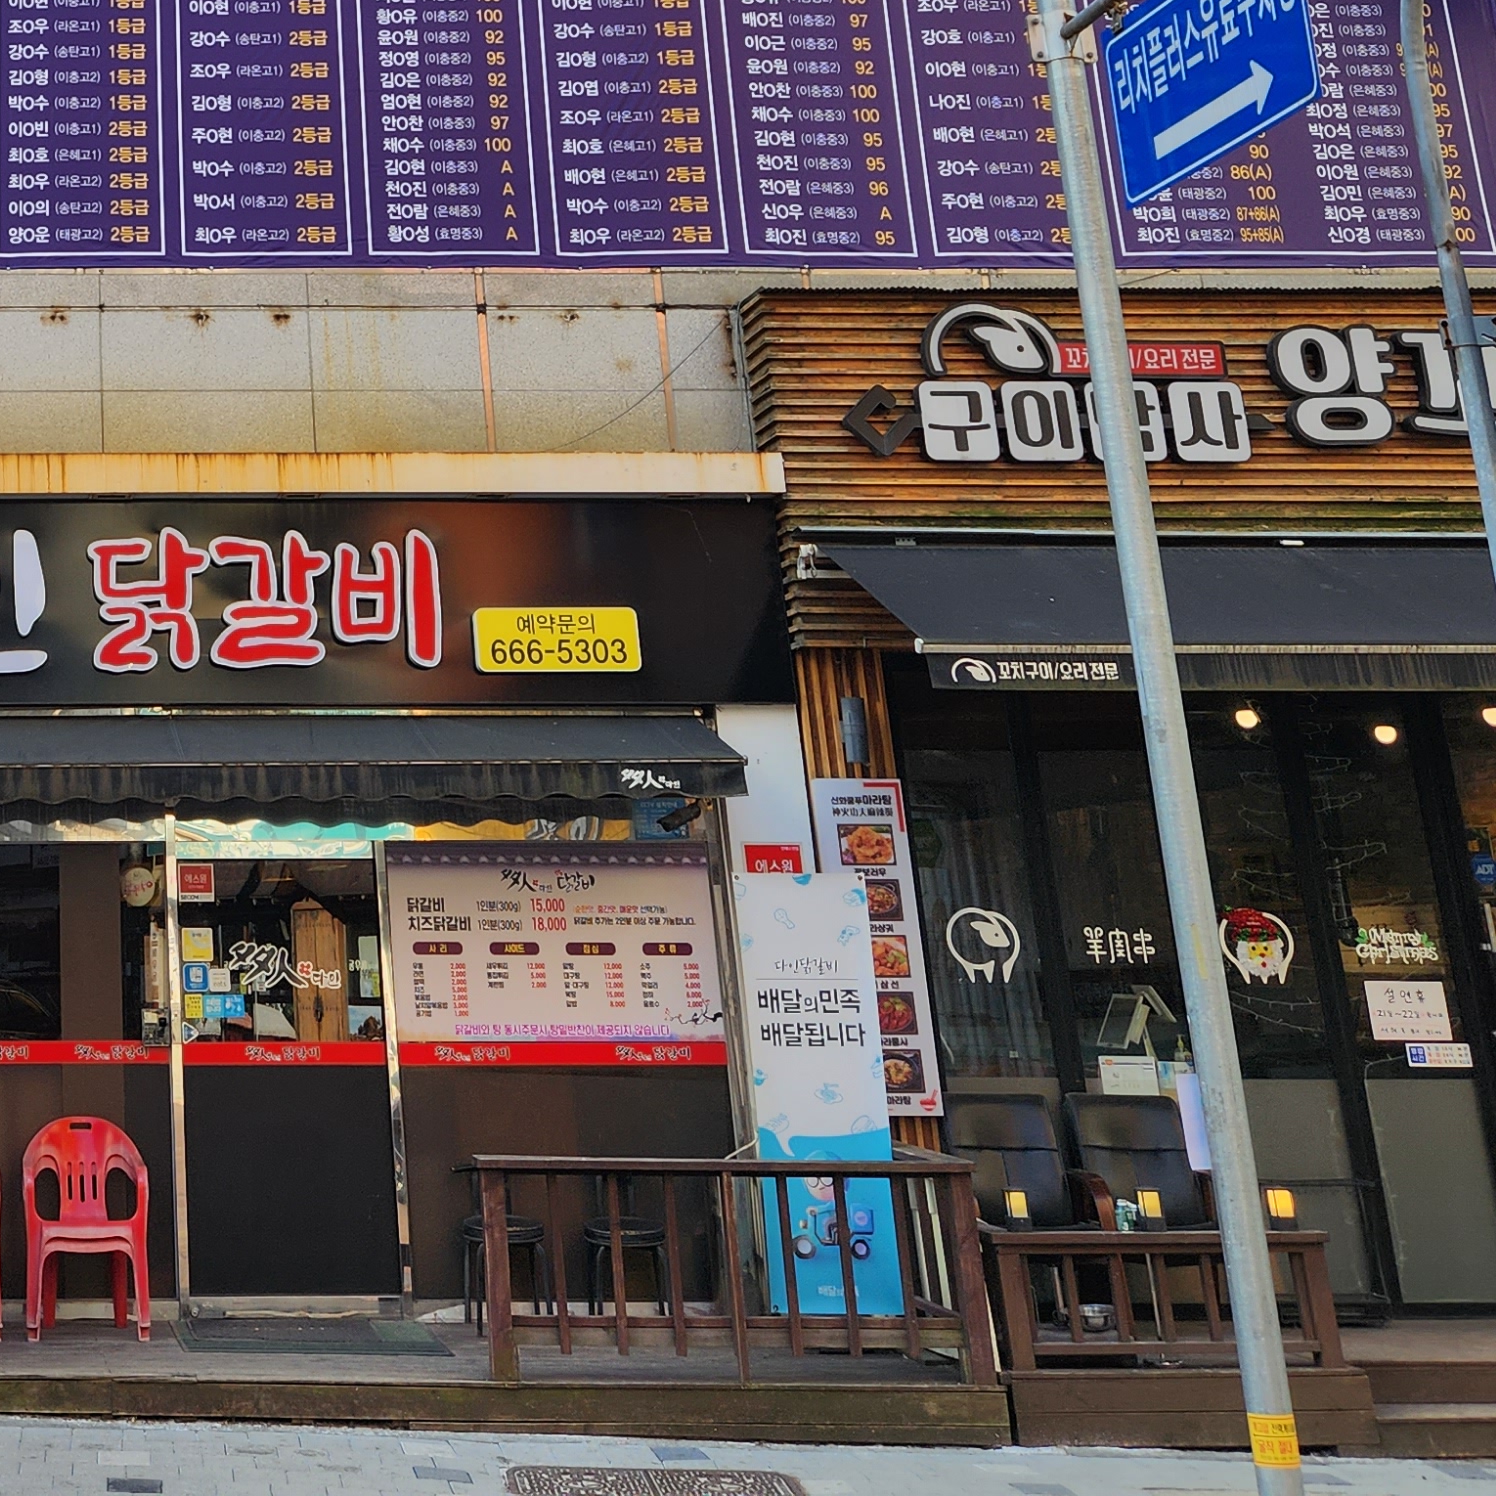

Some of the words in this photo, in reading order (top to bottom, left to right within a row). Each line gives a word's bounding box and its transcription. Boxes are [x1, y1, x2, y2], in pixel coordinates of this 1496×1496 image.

[1180, 345, 1217, 370] 전문
[87, 526, 442, 673] 닭갈비
[514, 613, 597, 636] 예약문의
[489, 636, 629, 668] 666-5303
[997, 661, 1089, 680] 꼬치구이/요리
[1090, 661, 1119, 680] 전문
[407, 897, 445, 913] 닭갈비
[530, 898, 565, 913] 15,000
[409, 916, 471, 932] 치즈닭갈비
[532, 917, 567, 931] 18,000
[758, 988, 861, 1014] 배달의민족
[761, 1023, 866, 1047] 배달됩니다
